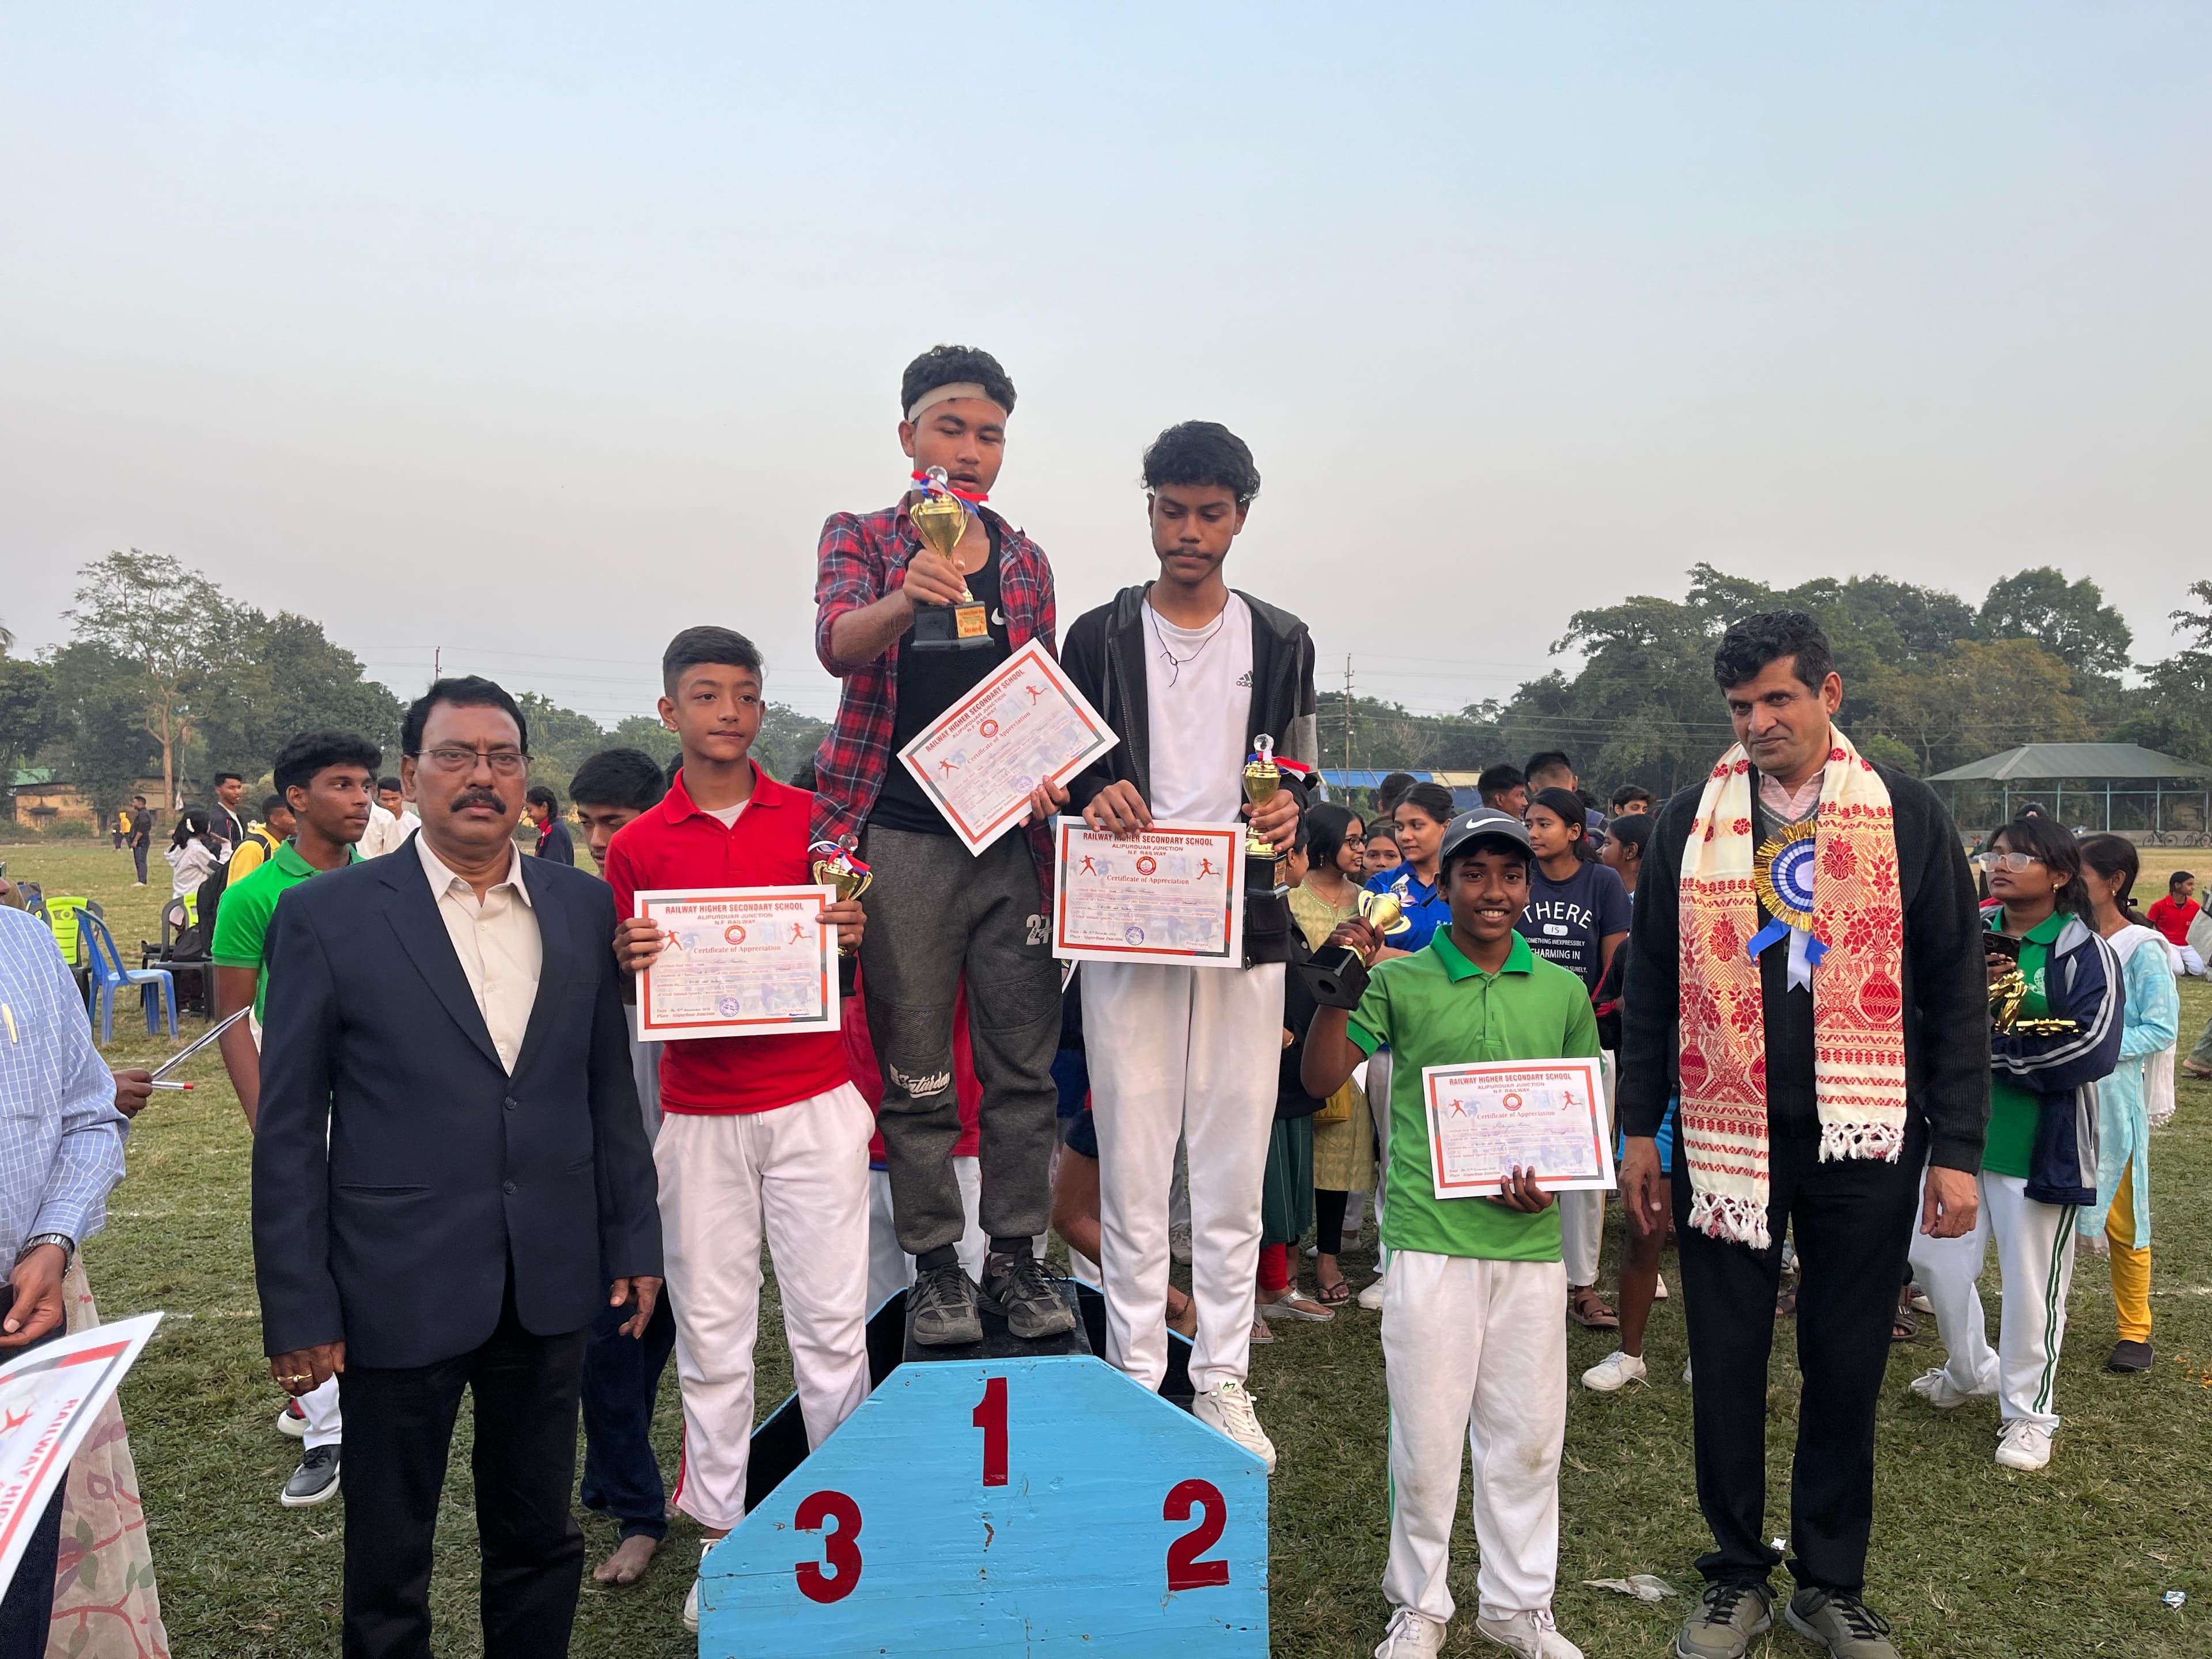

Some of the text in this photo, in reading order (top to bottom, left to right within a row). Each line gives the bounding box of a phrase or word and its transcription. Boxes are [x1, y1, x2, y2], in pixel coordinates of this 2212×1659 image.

[925, 669, 1025, 752] RAILWAY HIGHER SECONDARY SCHOOL
[983, 693, 1007, 714] JUNCTION
[976, 707, 997, 725] RAILWAY
[967, 741, 994, 764] Certificate
[999, 711, 1031, 737] Appreciation
[1083, 832, 1113, 841] RAILWAY
[1142, 835, 1184, 844] SECONDARY
[1185, 837, 1213, 846] SCHOOL
[1107, 874, 1140, 882] Certificate
[1149, 877, 1190, 885] Appreciation
[665, 902, 804, 914] RAILWAY HIGHER SECONDARY SCHOOL
[1522, 901, 1592, 929] THERE
[694, 945, 729, 955] Certificate
[738, 945, 781, 954] Appreciation
[1573, 950, 1580, 960] IN
[1449, 1077, 1476, 1085] RAILWAY
[19, 1398, 79, 1476] RAILWAY
[972, 1377, 1008, 1486] 1
[1163, 1479, 1229, 1591] 2
[794, 1490, 862, 1604] 3
